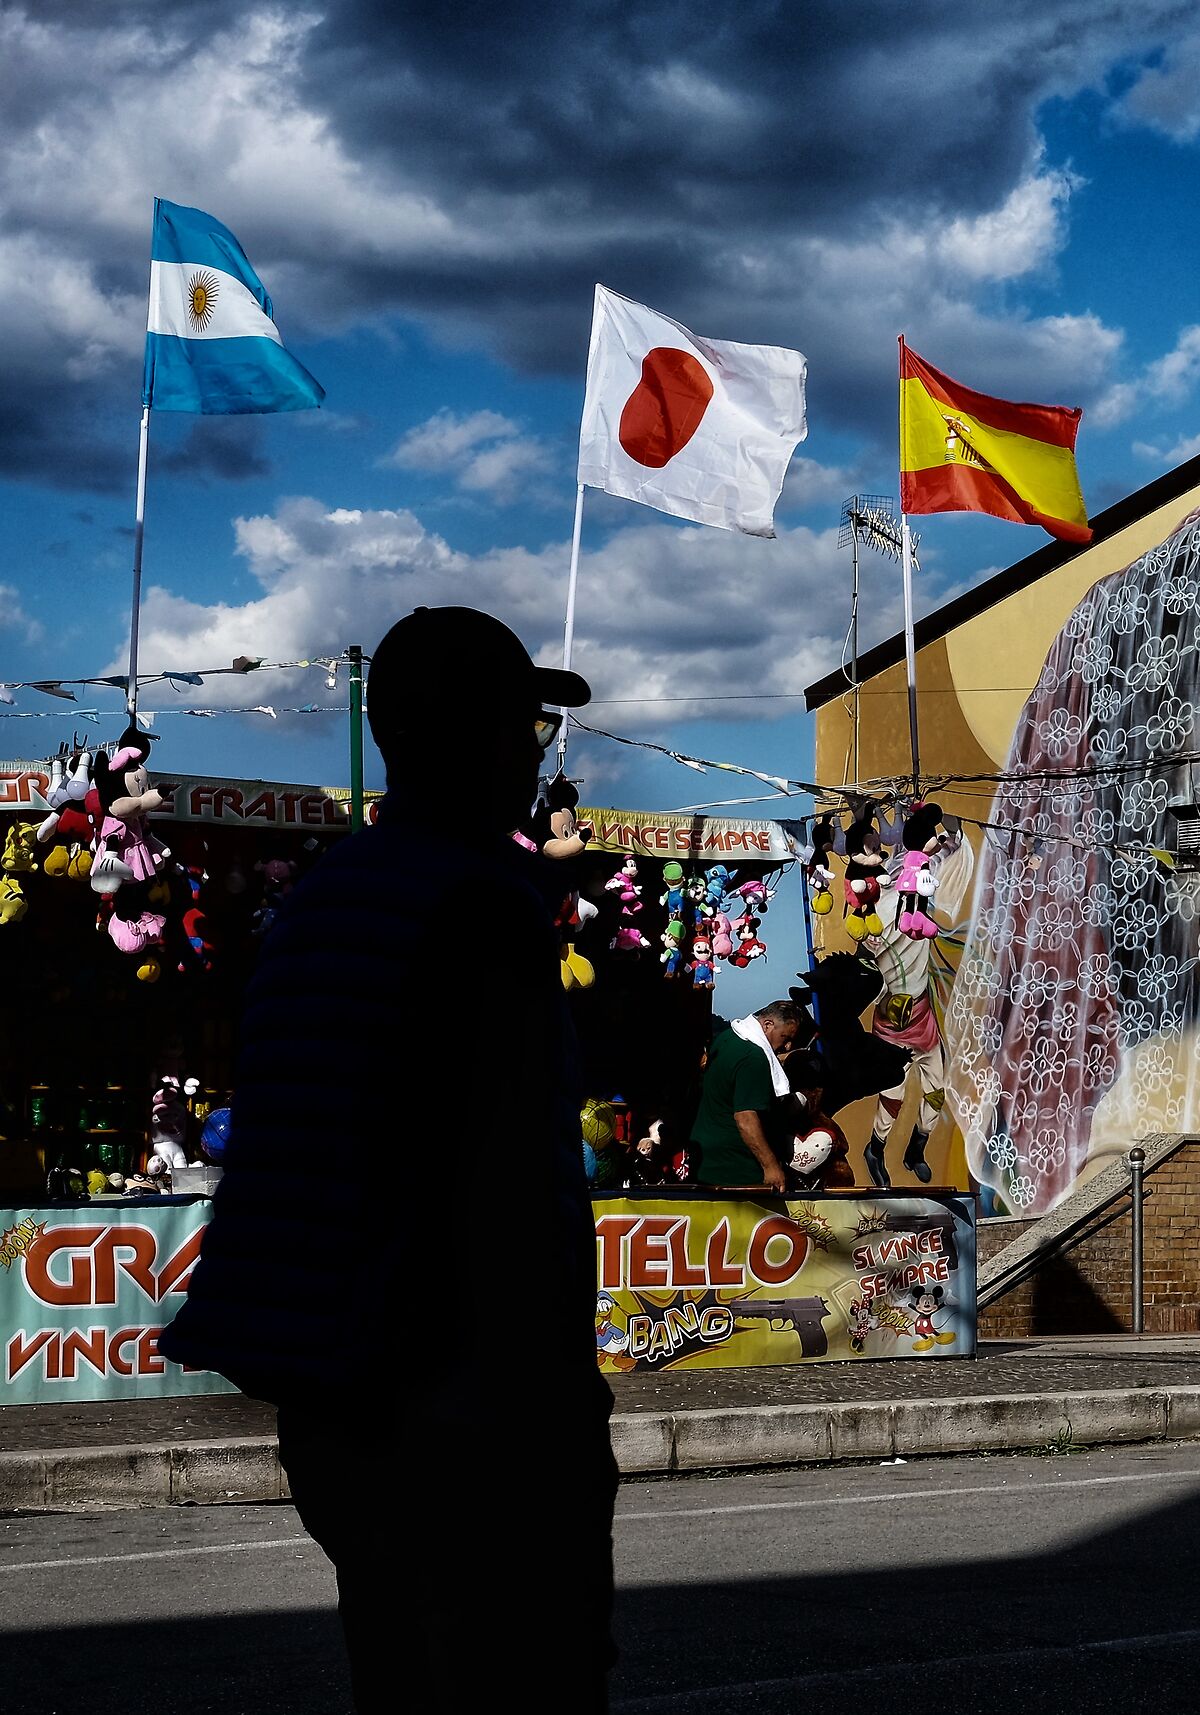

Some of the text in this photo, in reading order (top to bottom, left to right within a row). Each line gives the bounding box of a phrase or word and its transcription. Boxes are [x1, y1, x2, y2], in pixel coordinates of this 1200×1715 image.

[601, 823, 670, 849] VINCE
[675, 828, 772, 852] SEMPRE
[852, 1227, 944, 1271] SI VINCE
[859, 1256, 950, 1298] SEMPRE
[629, 1302, 734, 1362] BANG
[7, 1327, 166, 1382] VINCE
